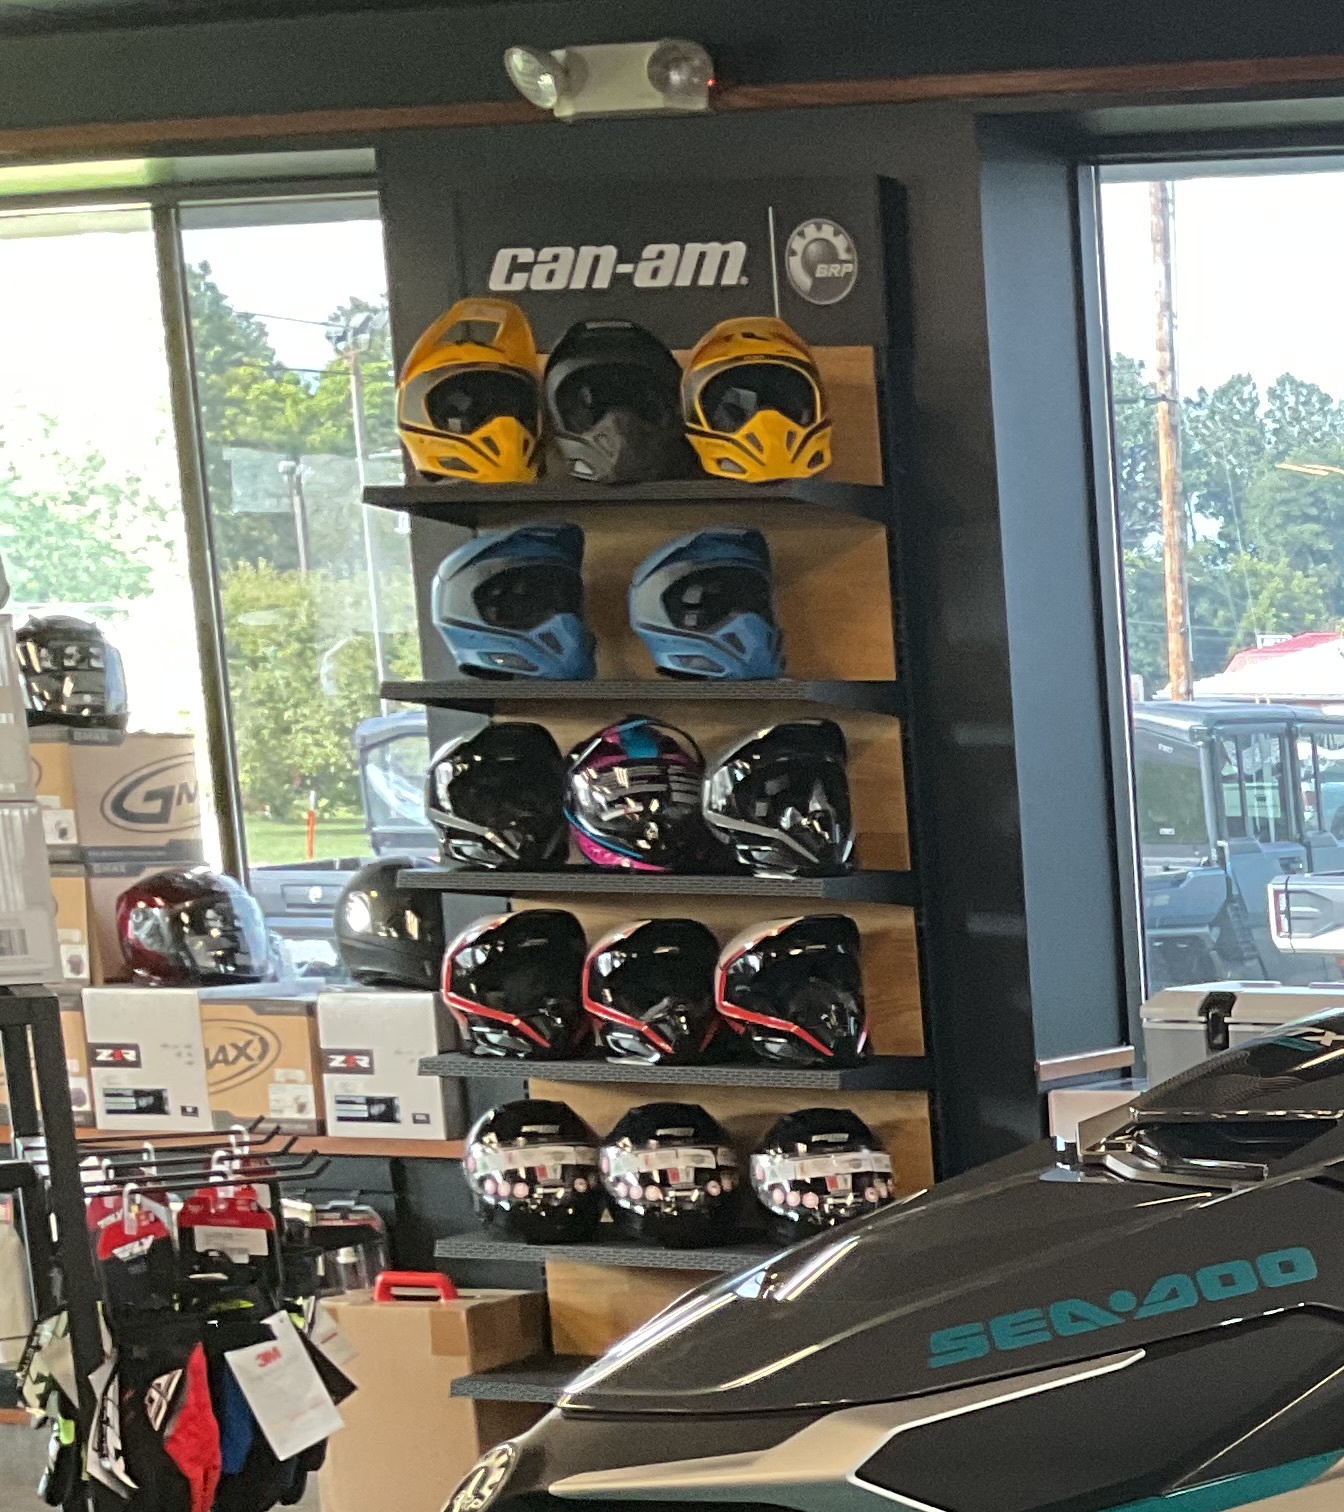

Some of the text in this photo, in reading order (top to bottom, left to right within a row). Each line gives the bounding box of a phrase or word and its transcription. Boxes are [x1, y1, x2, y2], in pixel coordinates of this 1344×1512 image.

[489, 241, 747, 291] can-am
[815, 263, 853, 278] BRP
[255, 1346, 281, 1368] 3M
